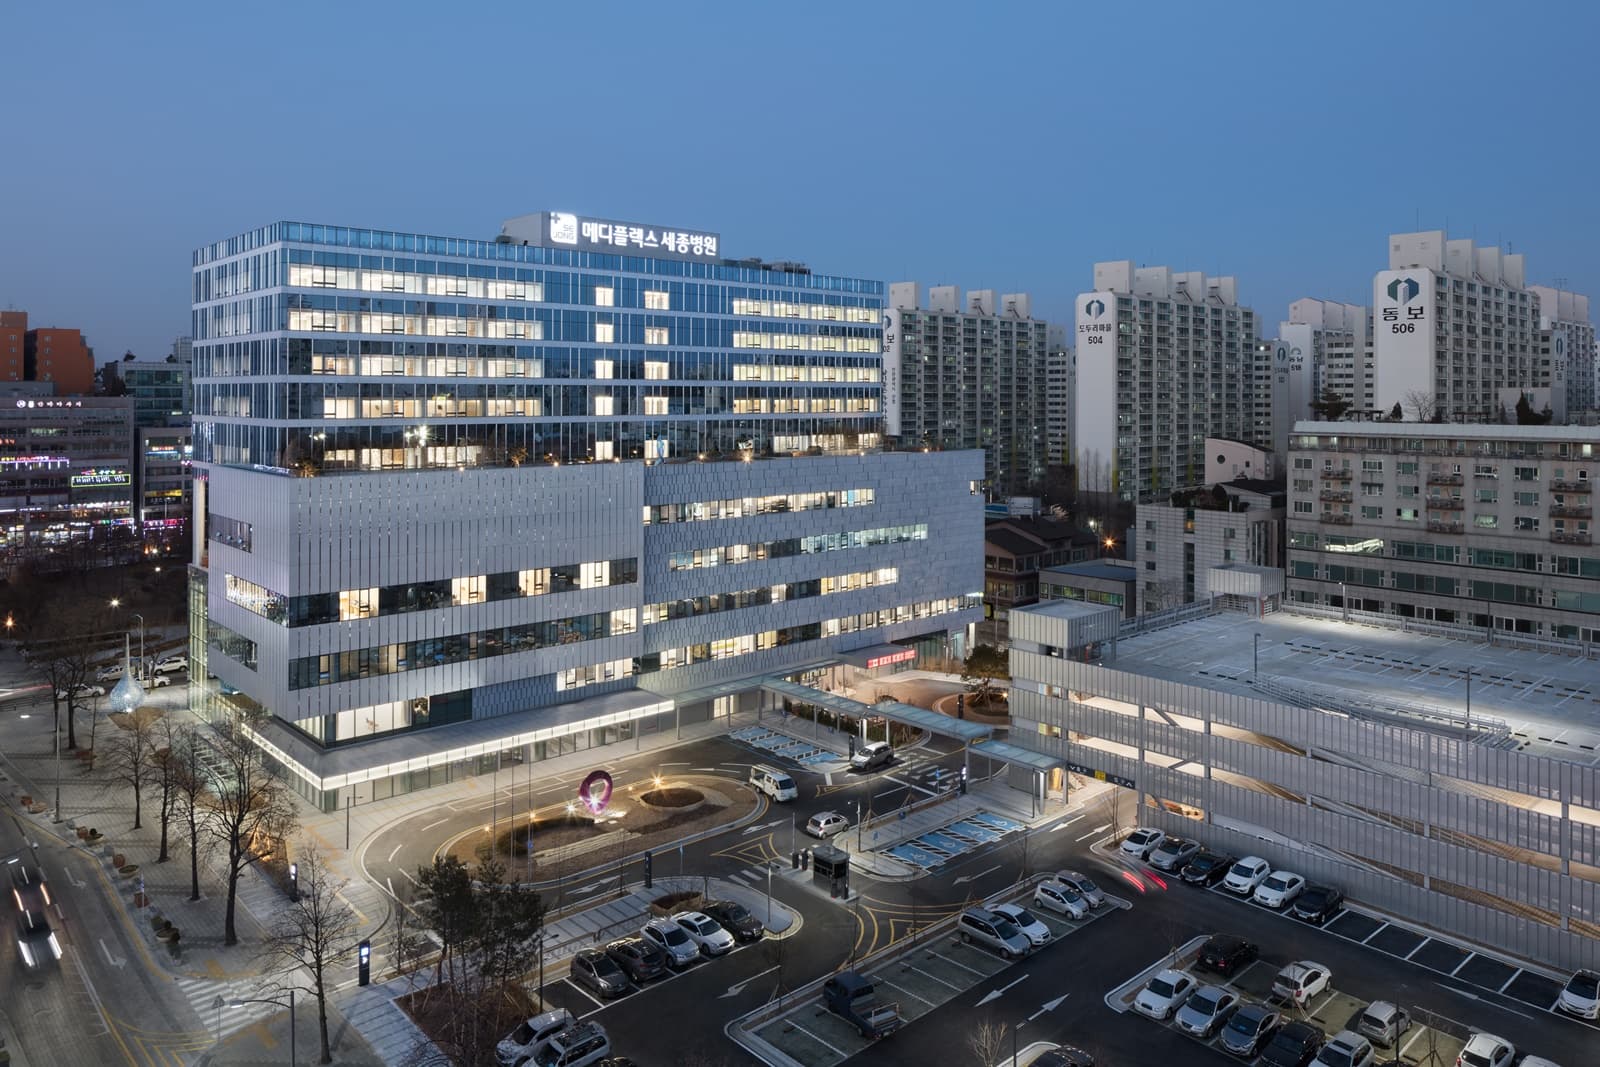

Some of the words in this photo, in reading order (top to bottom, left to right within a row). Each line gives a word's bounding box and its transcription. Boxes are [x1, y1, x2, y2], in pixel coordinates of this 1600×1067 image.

[553, 231, 575, 241] JONG
[581, 222, 659, 248] 메디플렉스
[661, 231, 717, 256] 세종병원
[1391, 323, 1415, 334] 506
[1088, 336, 1103, 344] 504
